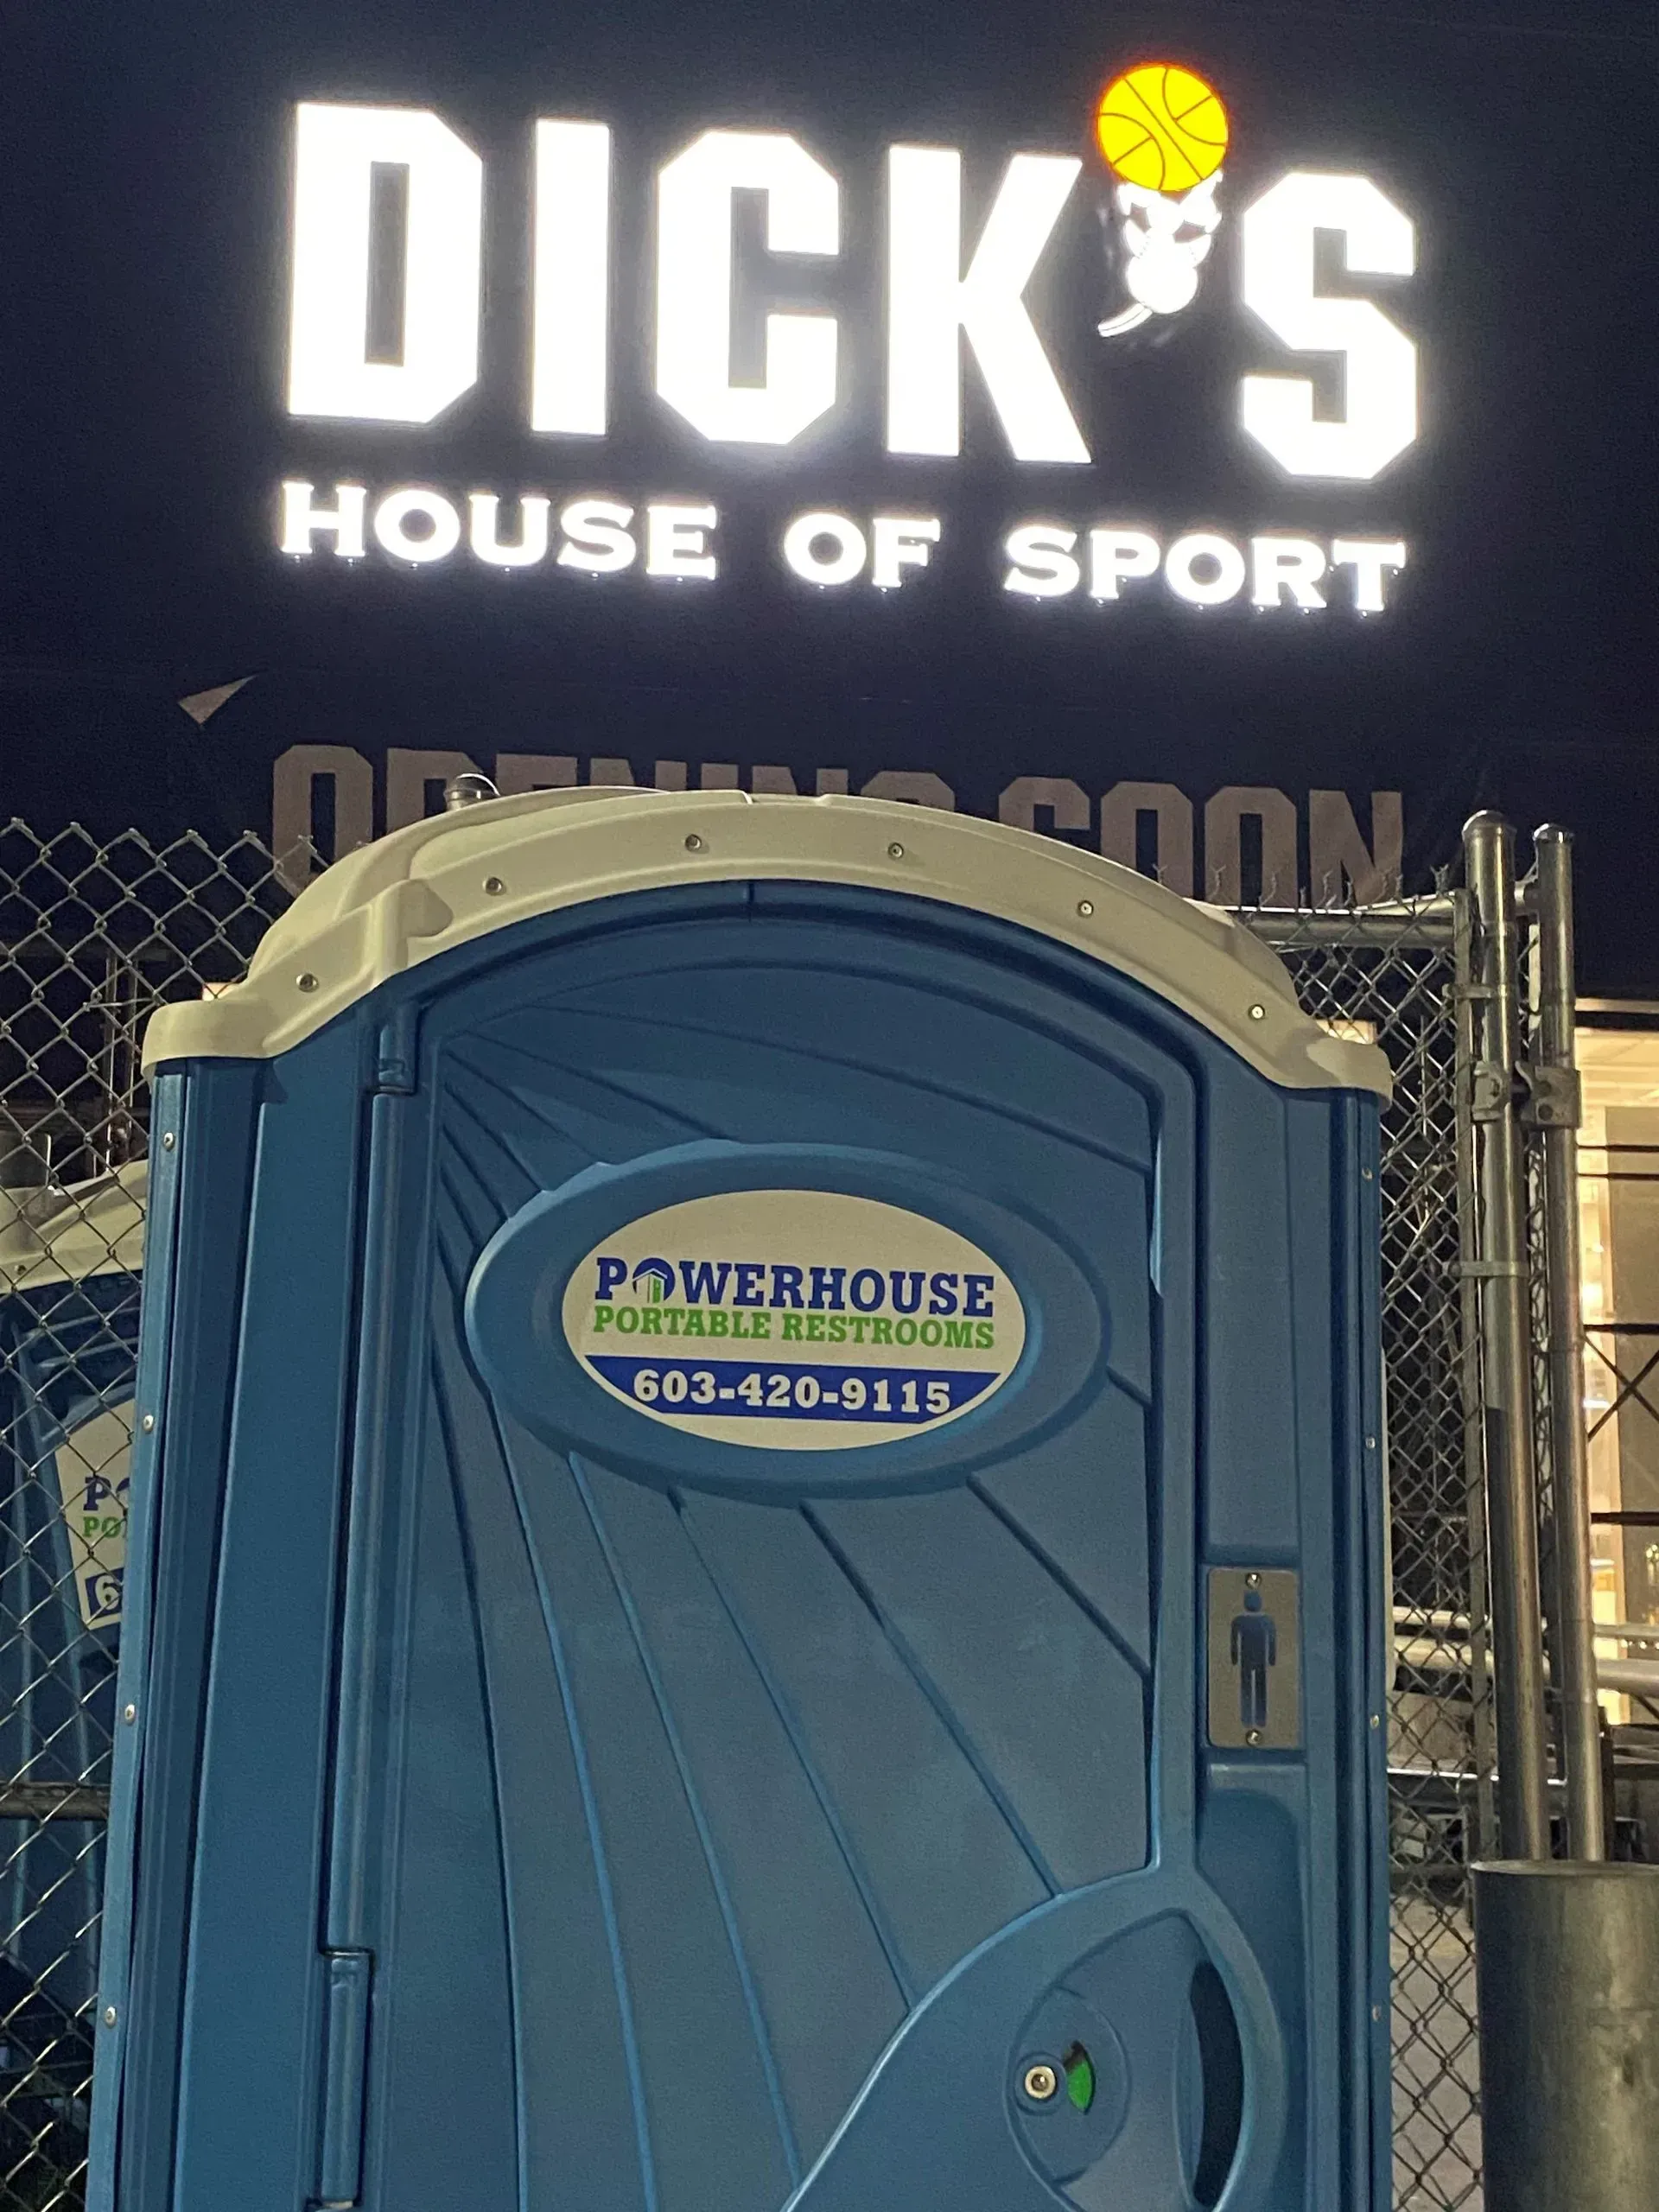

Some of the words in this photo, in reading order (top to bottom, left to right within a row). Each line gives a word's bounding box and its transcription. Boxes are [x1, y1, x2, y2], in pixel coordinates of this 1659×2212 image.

[288, 63, 1417, 480] DICK'S
[281, 480, 717, 580] HOUSE
[784, 512, 941, 588] OF
[1003, 524, 1406, 612] SPORT
[594, 1256, 995, 1318] POWERHOUSE
[593, 1305, 771, 1340] PORTABLE
[781, 1313, 995, 1350] RESTROOMS
[632, 1368, 951, 1414] 603-420-9115
[82, 1516, 126, 1538] PO
